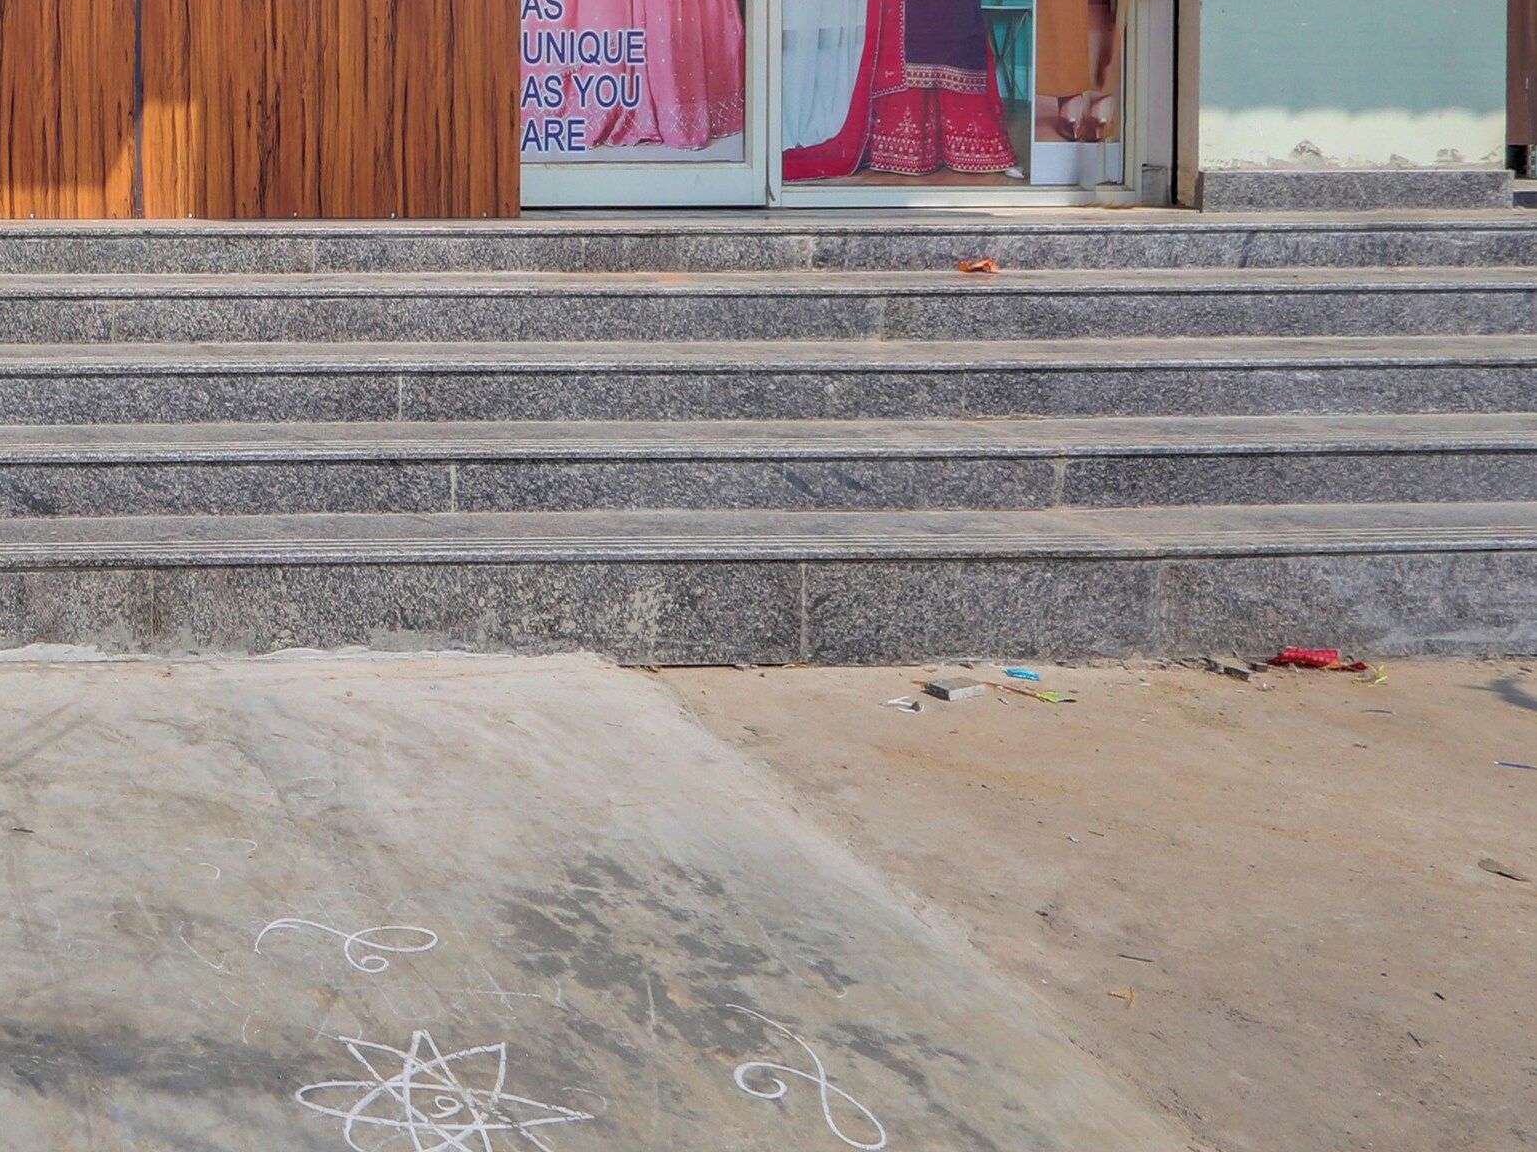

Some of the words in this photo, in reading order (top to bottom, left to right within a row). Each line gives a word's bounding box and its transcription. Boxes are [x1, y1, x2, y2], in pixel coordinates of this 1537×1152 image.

[523, 31, 646, 65] UNIQUE
[521, 75, 564, 108] AS
[573, 75, 641, 109] YOU
[521, 119, 588, 153] ARE
